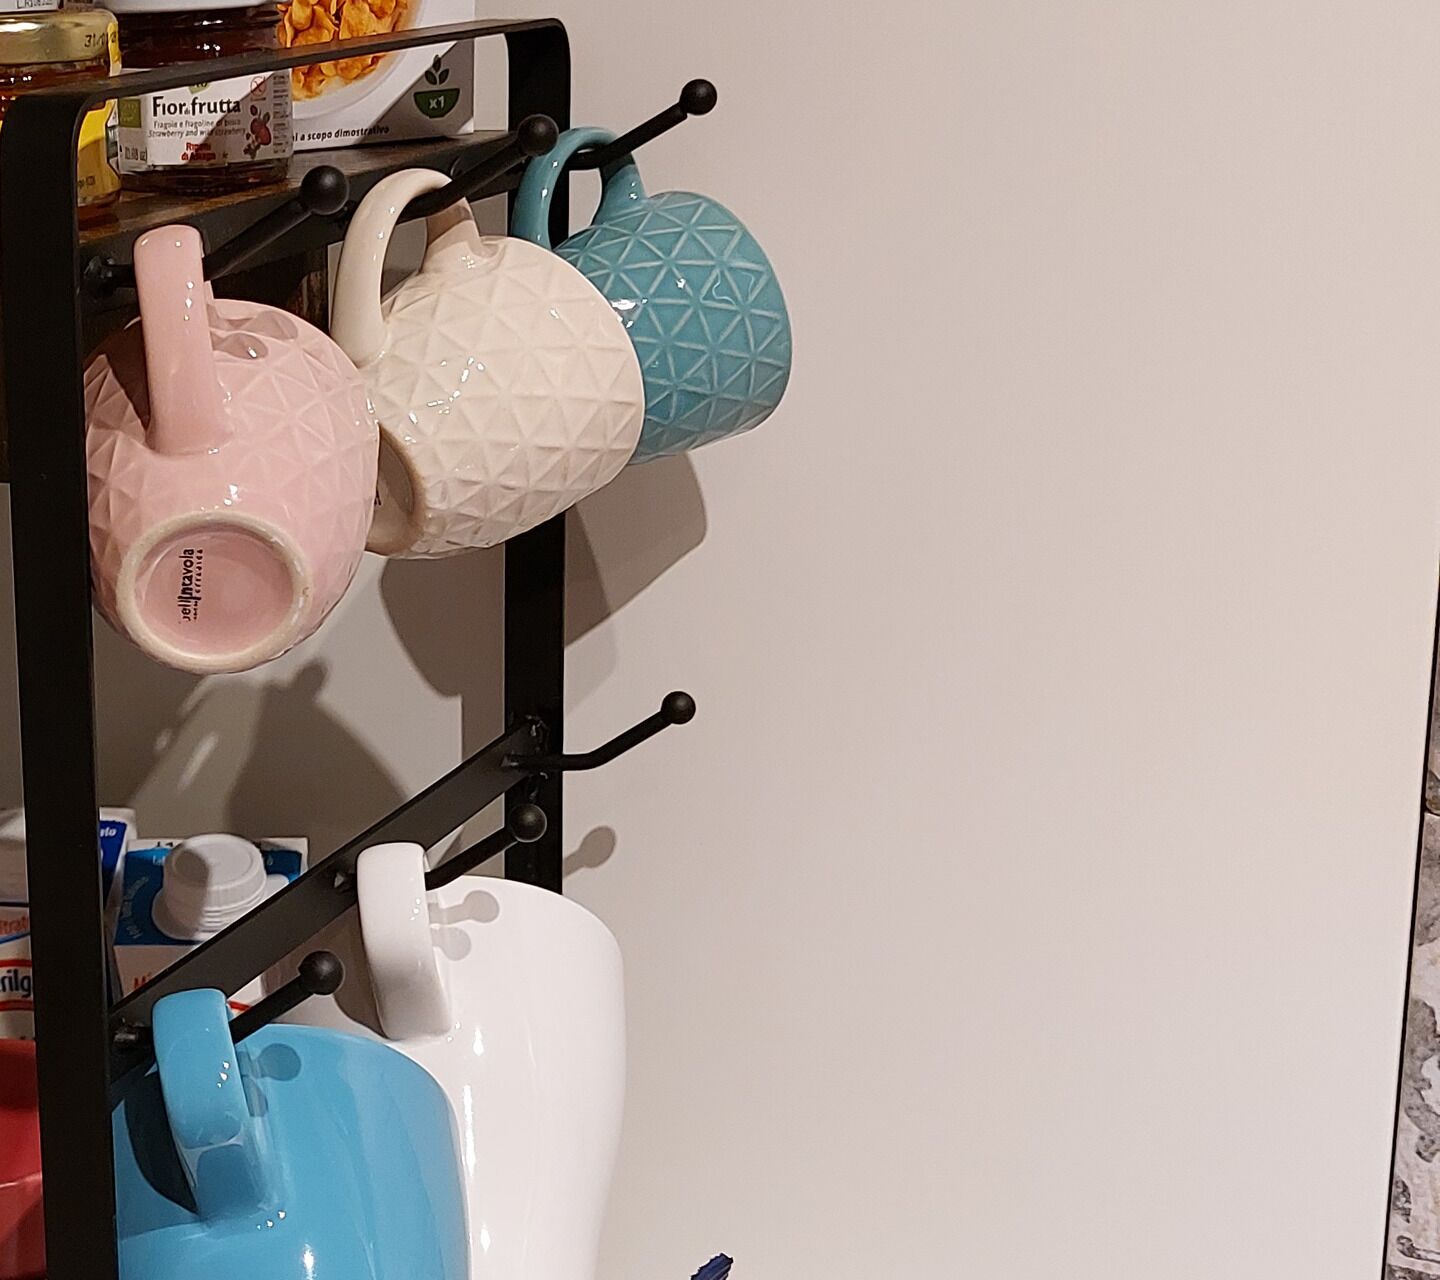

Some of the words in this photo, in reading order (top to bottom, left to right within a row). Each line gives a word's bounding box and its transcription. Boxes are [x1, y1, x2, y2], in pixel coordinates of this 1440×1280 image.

[153, 96, 186, 118] Fior
[191, 96, 241, 117] frutta
[429, 94, 445, 109] x1
[307, 131, 333, 144] scopo
[334, 126, 390, 139] dimostrativo
